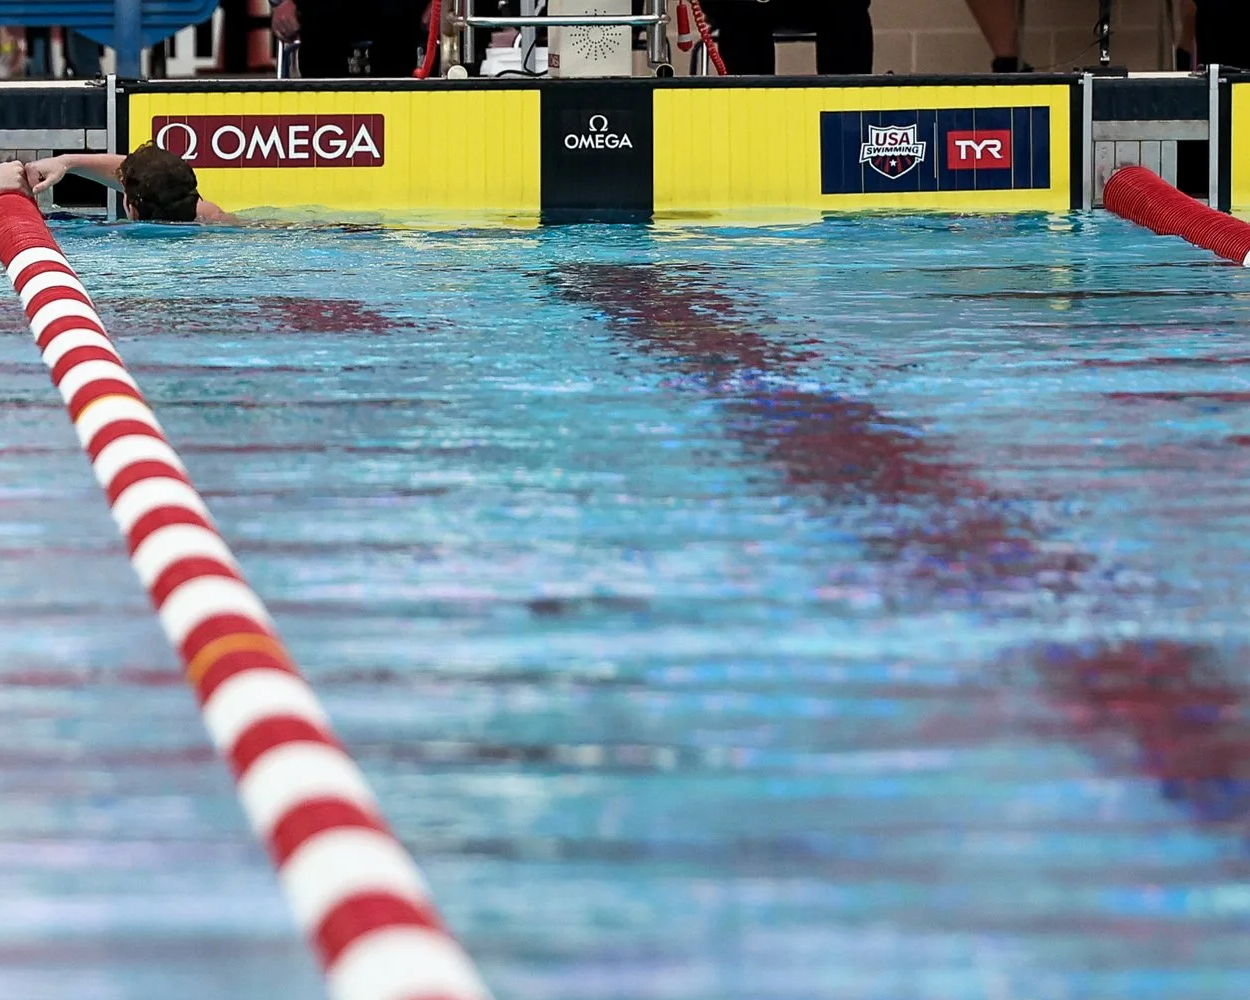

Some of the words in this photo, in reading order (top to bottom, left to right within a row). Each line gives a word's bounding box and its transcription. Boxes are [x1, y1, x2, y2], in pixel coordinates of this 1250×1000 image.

[211, 123, 381, 160] OMEGA
[564, 133, 633, 149] OMEGA
[875, 132, 911, 146] USA
[866, 146, 919, 155] SWIMMING
[955, 139, 1003, 160] TYR
